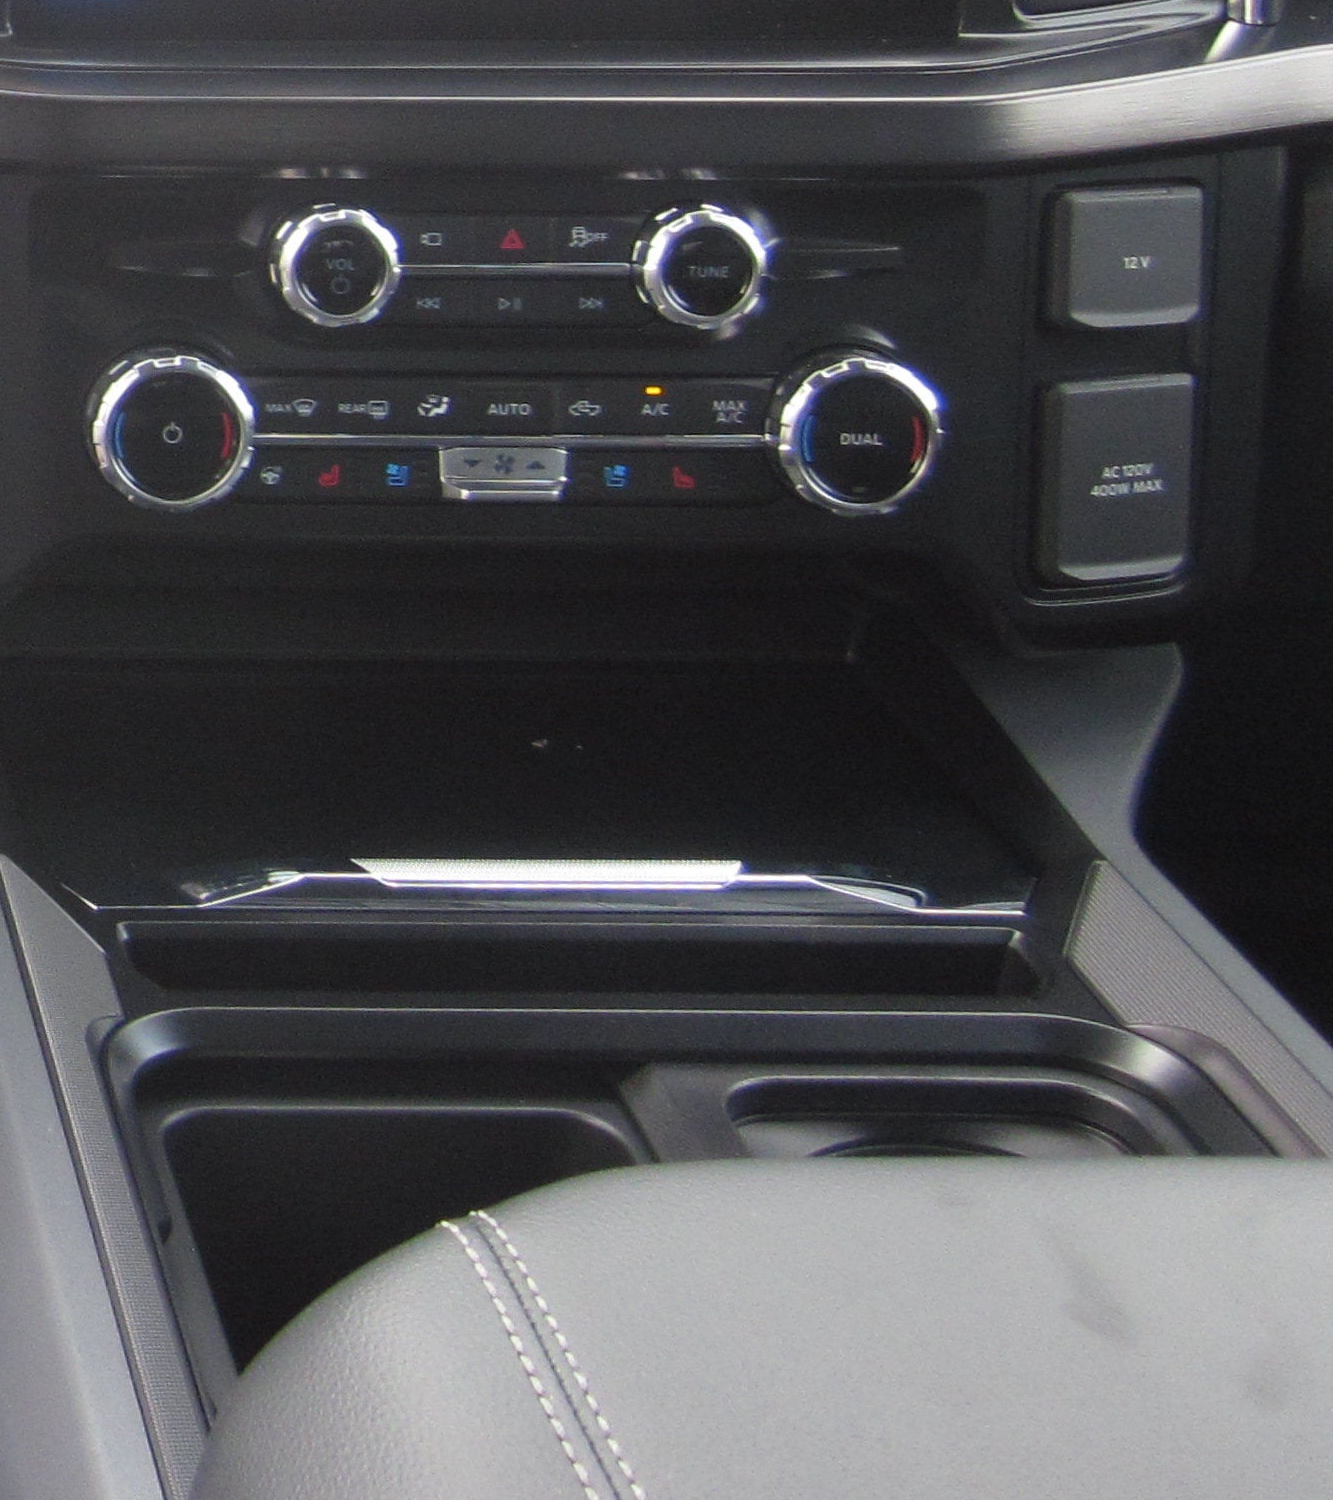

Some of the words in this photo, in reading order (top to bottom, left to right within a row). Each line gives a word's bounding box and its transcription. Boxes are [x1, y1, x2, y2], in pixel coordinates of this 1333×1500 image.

[325, 258, 355, 272] VOL
[688, 265, 729, 279] TUNE
[265, 402, 293, 415] MAX
[337, 402, 368, 415] REAR
[486, 402, 531, 416] AUTO
[640, 402, 670, 416] A/C
[712, 399, 746, 412] MAX
[715, 412, 745, 425] A/C
[838, 431, 883, 447] DUAL
[1101, 466, 1120, 479] AC
[1132, 477, 1164, 494] MAX
